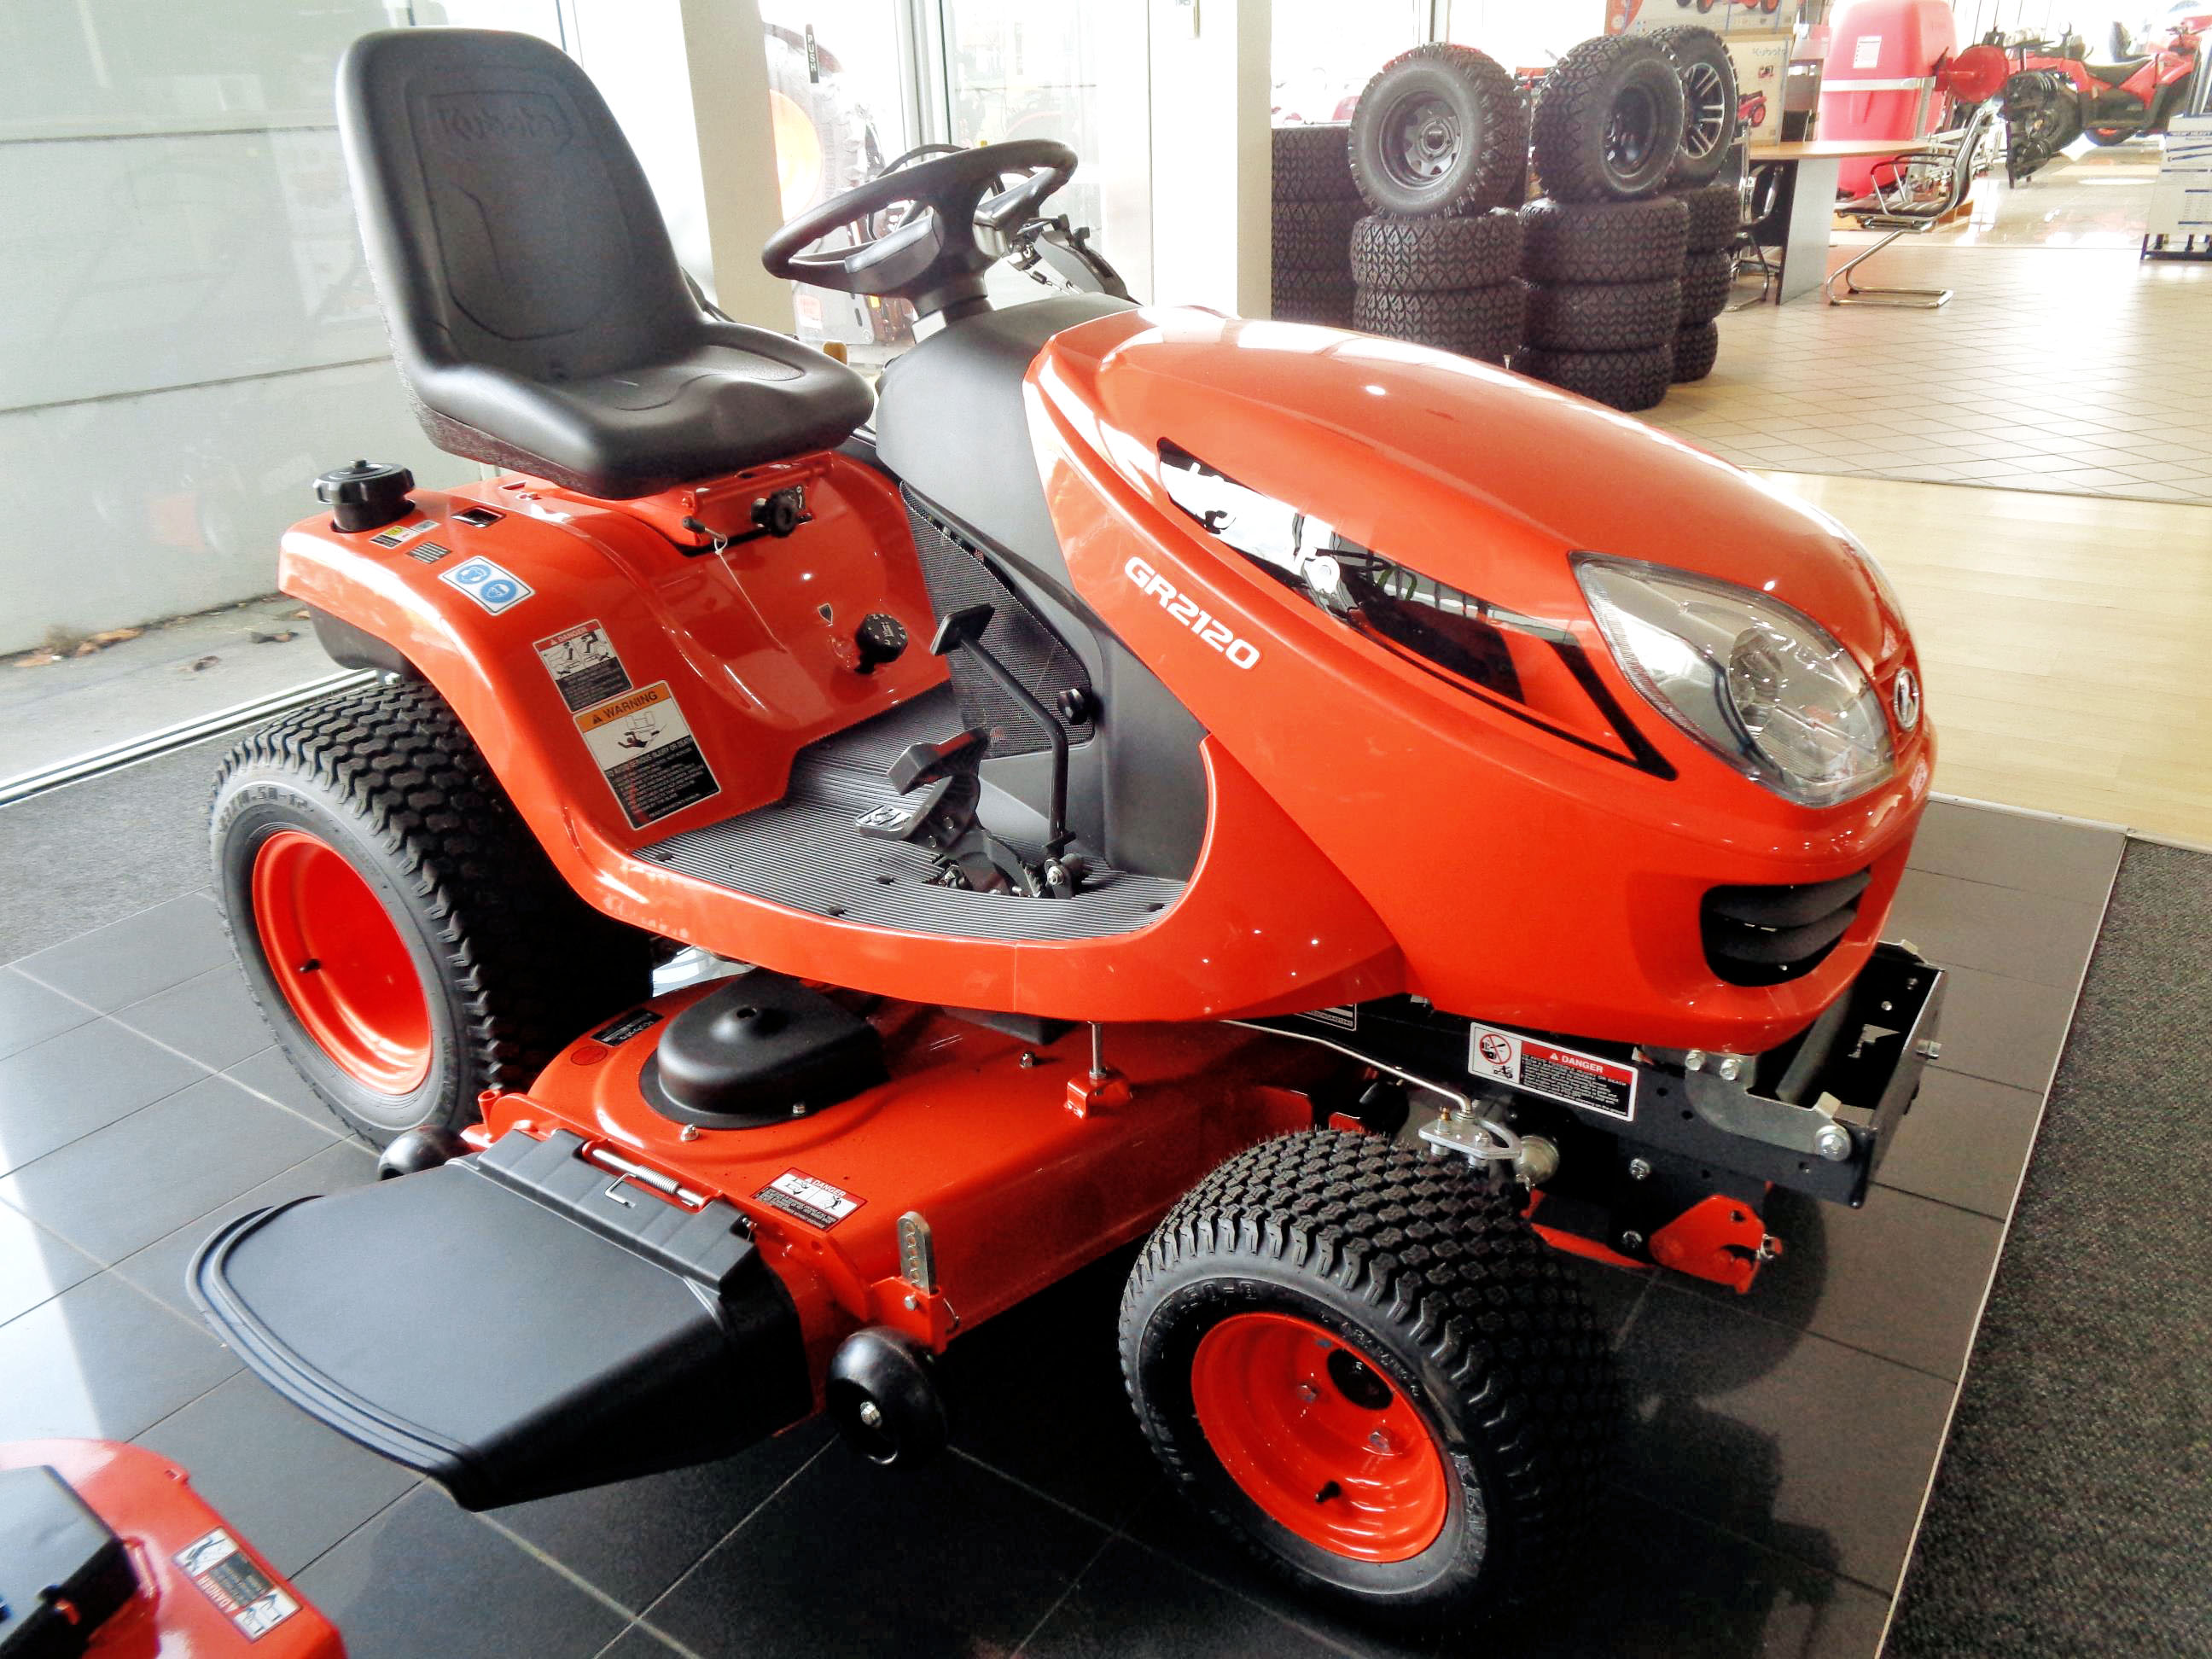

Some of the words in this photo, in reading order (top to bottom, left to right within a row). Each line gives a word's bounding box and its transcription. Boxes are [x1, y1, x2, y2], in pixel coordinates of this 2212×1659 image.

[807, 34, 817, 72] PUSH
[1125, 556, 1261, 670] GR2120
[557, 626, 588, 641] DANGER
[603, 691, 658, 719] WARNING
[1562, 1055, 1604, 1074] DANGER
[812, 1178, 847, 1197] DANGER
[197, 1575, 233, 1609] DANGER
